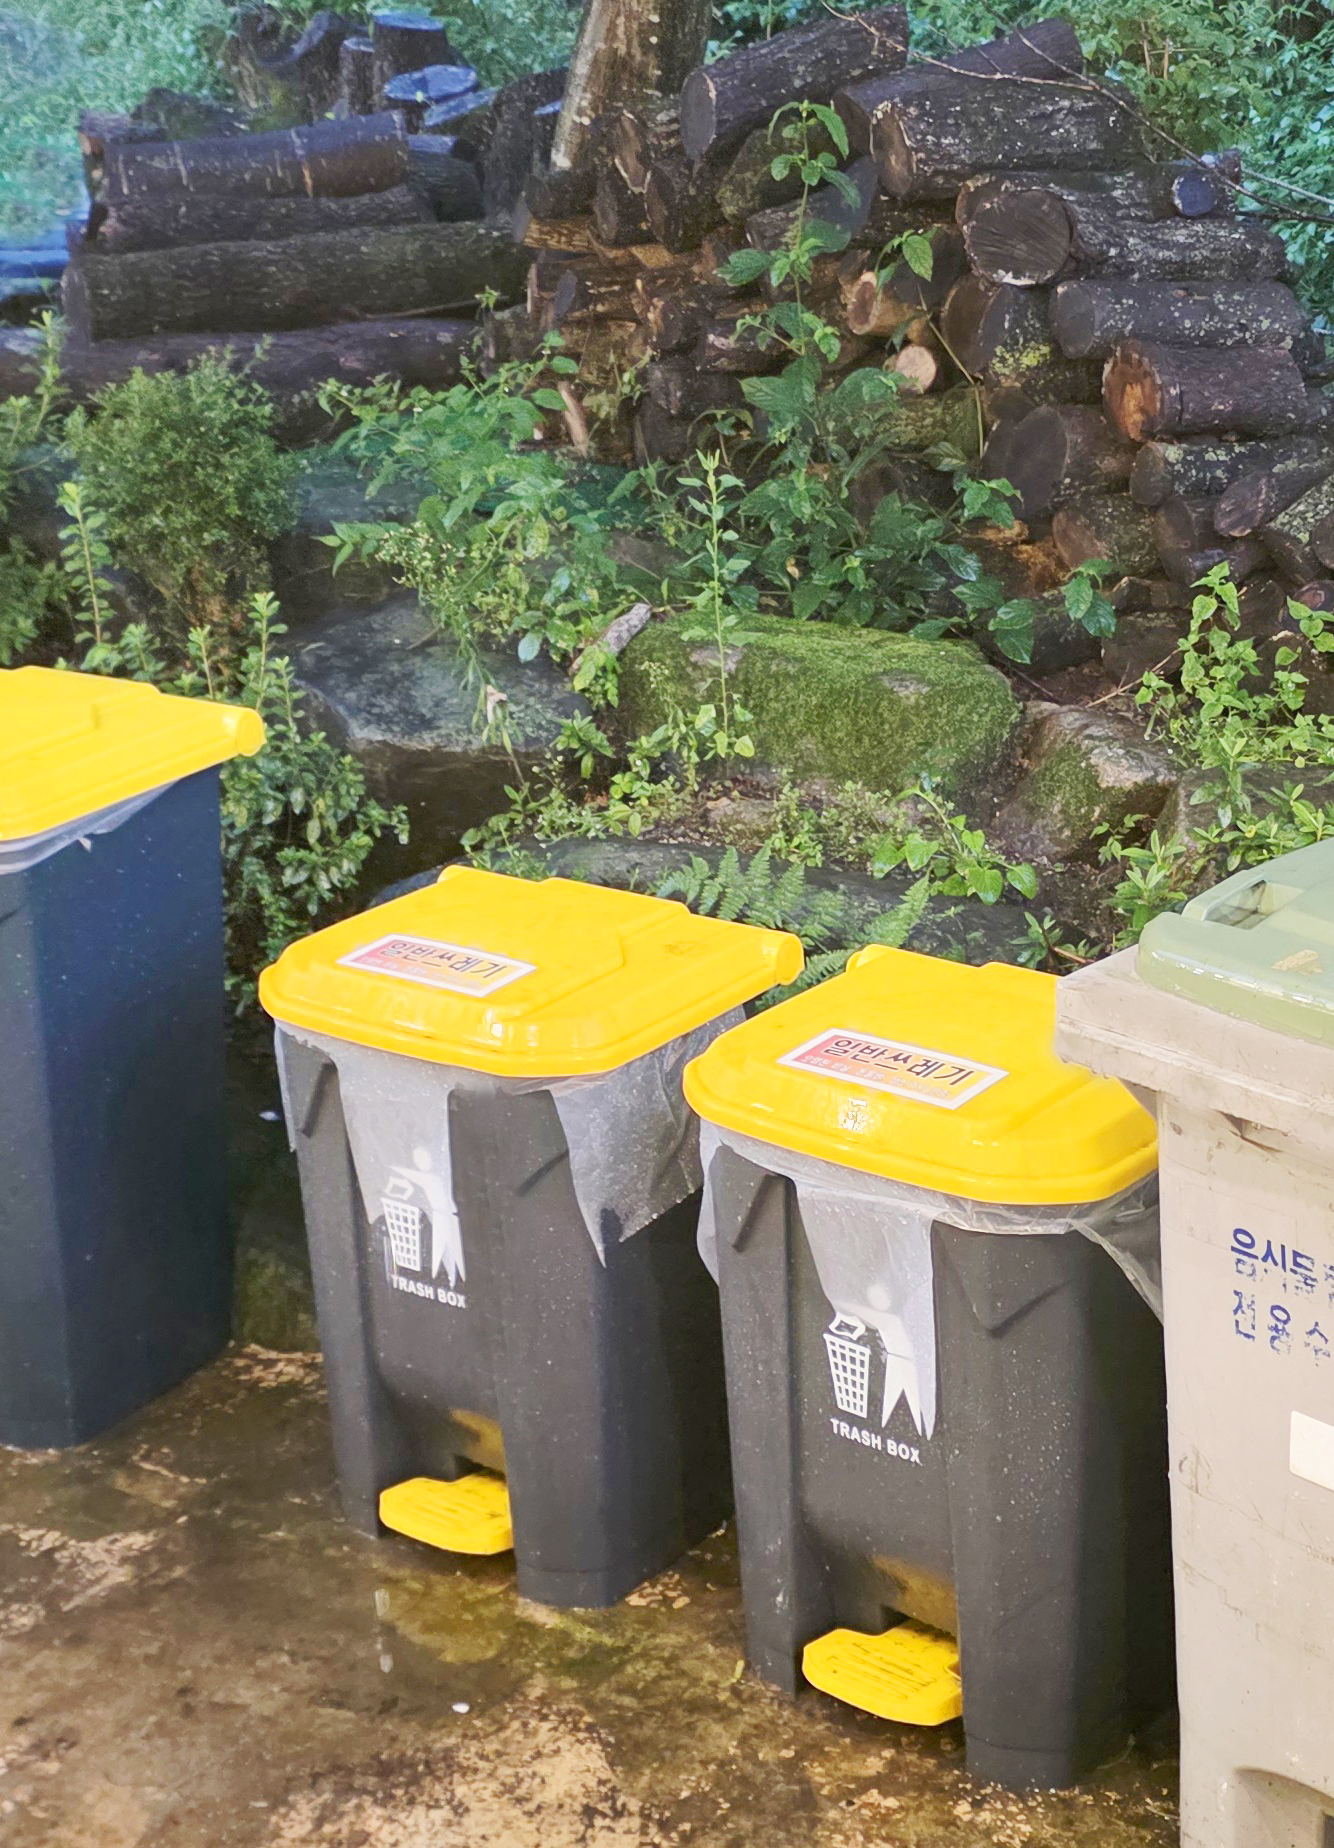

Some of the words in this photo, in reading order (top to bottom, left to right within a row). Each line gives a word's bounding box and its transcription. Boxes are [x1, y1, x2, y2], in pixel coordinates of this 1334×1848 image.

[379, 942, 508, 979] 일반쓰레기
[822, 1038, 975, 1086] 일반쓰레기
[390, 1274, 435, 1300] TRASH
[437, 1288, 466, 1309] BOX
[829, 1418, 882, 1451] TRASH
[886, 1439, 924, 1467] BOX
